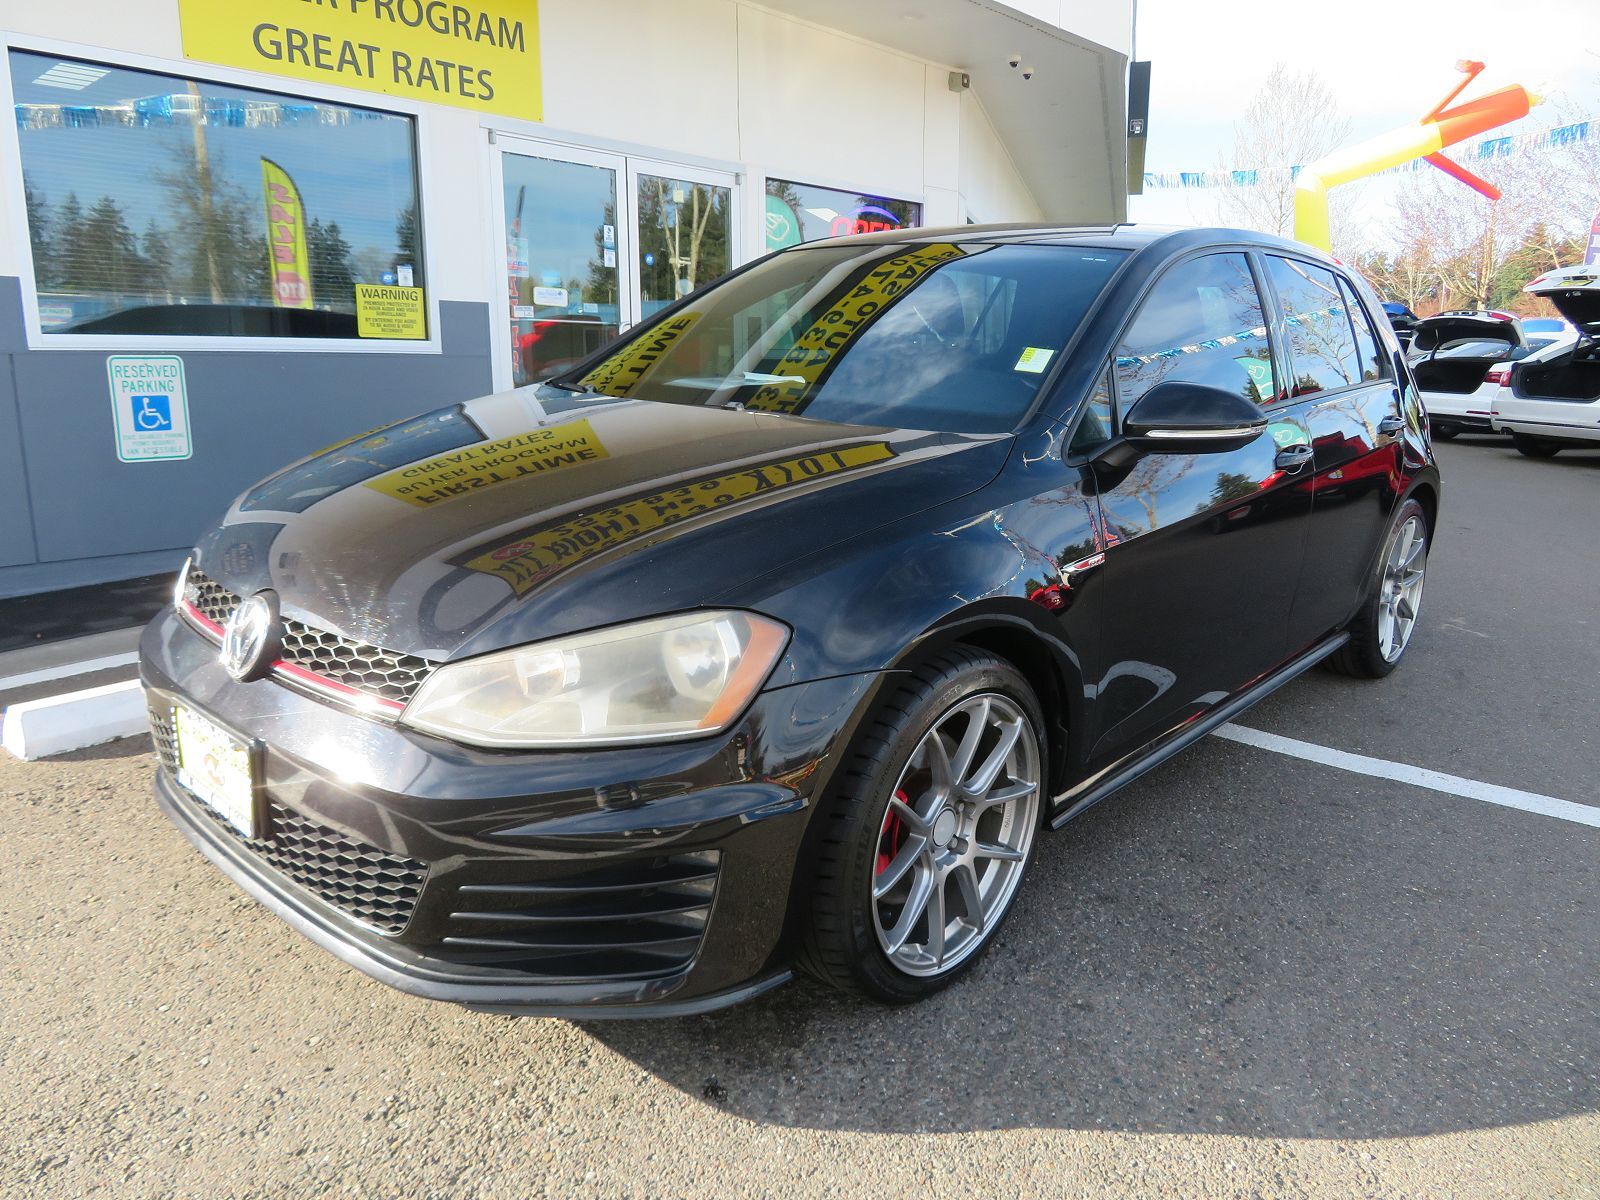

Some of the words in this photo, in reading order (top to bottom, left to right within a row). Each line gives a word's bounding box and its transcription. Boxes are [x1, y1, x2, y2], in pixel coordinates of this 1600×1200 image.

[252, 22, 381, 79] GREAT
[391, 50, 495, 101] RATES
[831, 217, 905, 237] OPE
[361, 288, 418, 301] WARNING
[114, 365, 178, 378] RESERVED
[121, 380, 175, 393] PARKING
